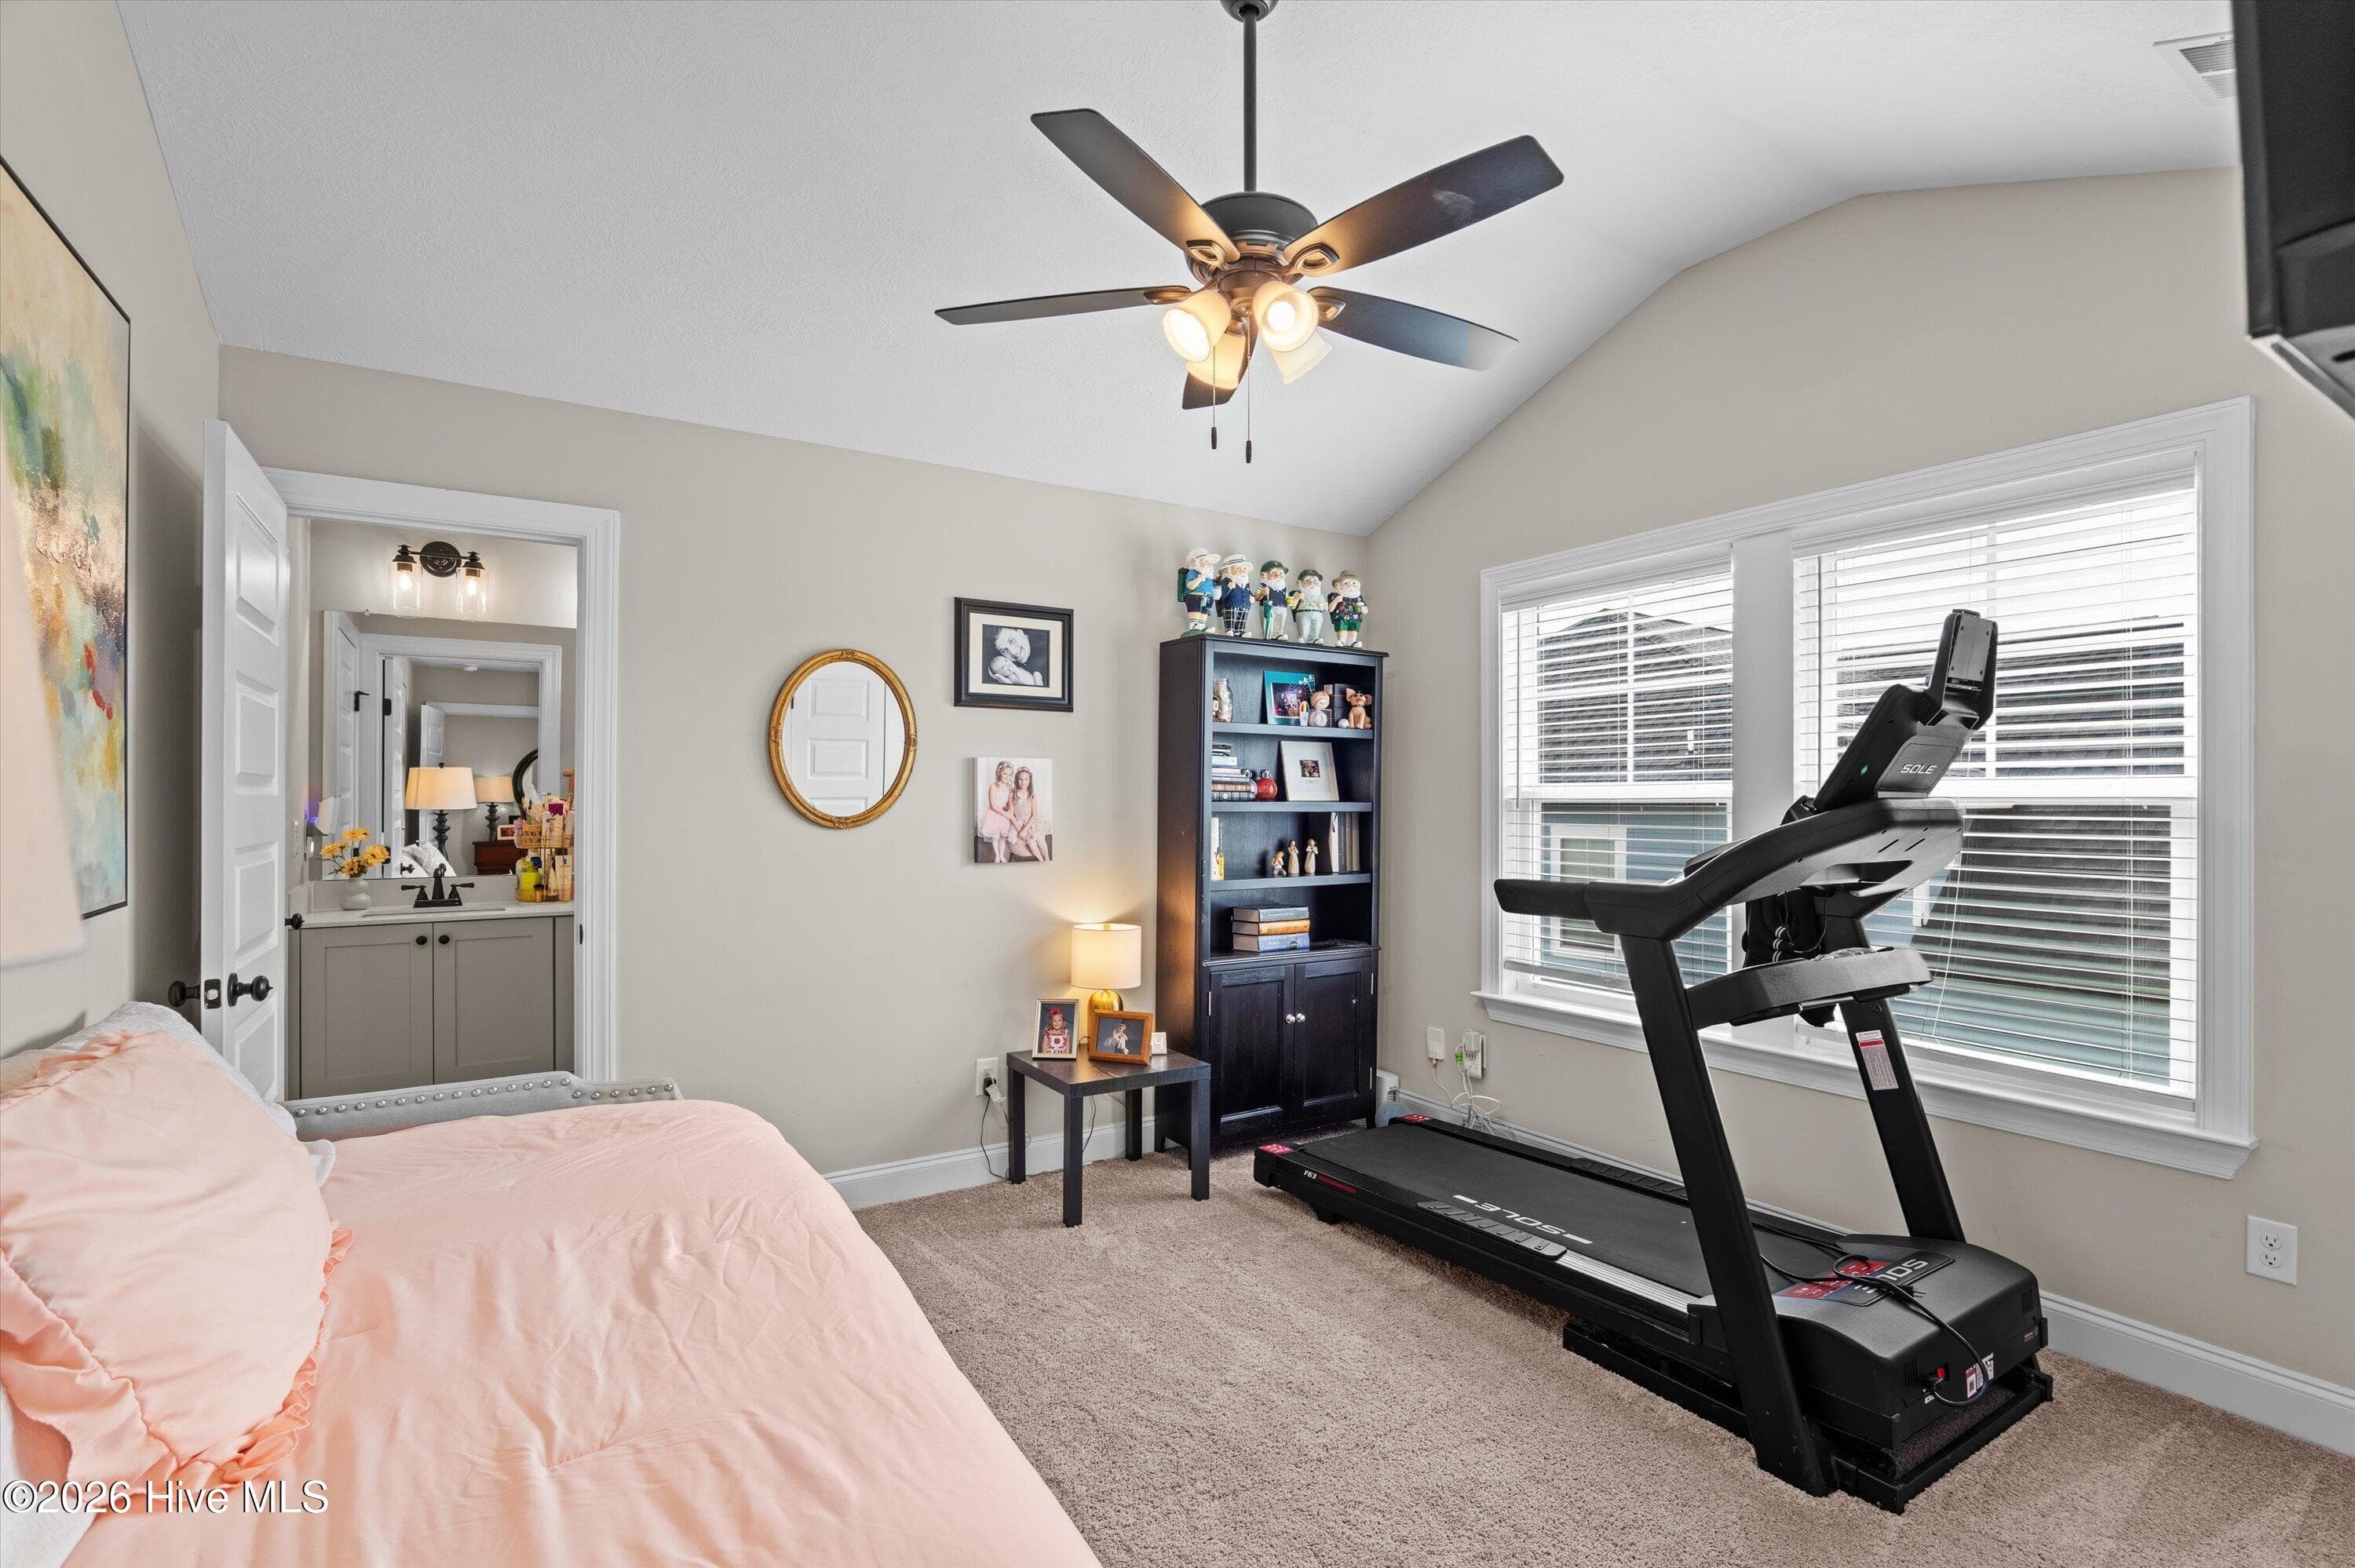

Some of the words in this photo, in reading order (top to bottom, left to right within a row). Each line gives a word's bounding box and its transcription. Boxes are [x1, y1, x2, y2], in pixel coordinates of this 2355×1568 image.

[1900, 764, 1937, 774] SOLE
[1303, 1169, 1317, 1180] F63
[1474, 1202, 1566, 1234] SOLE
